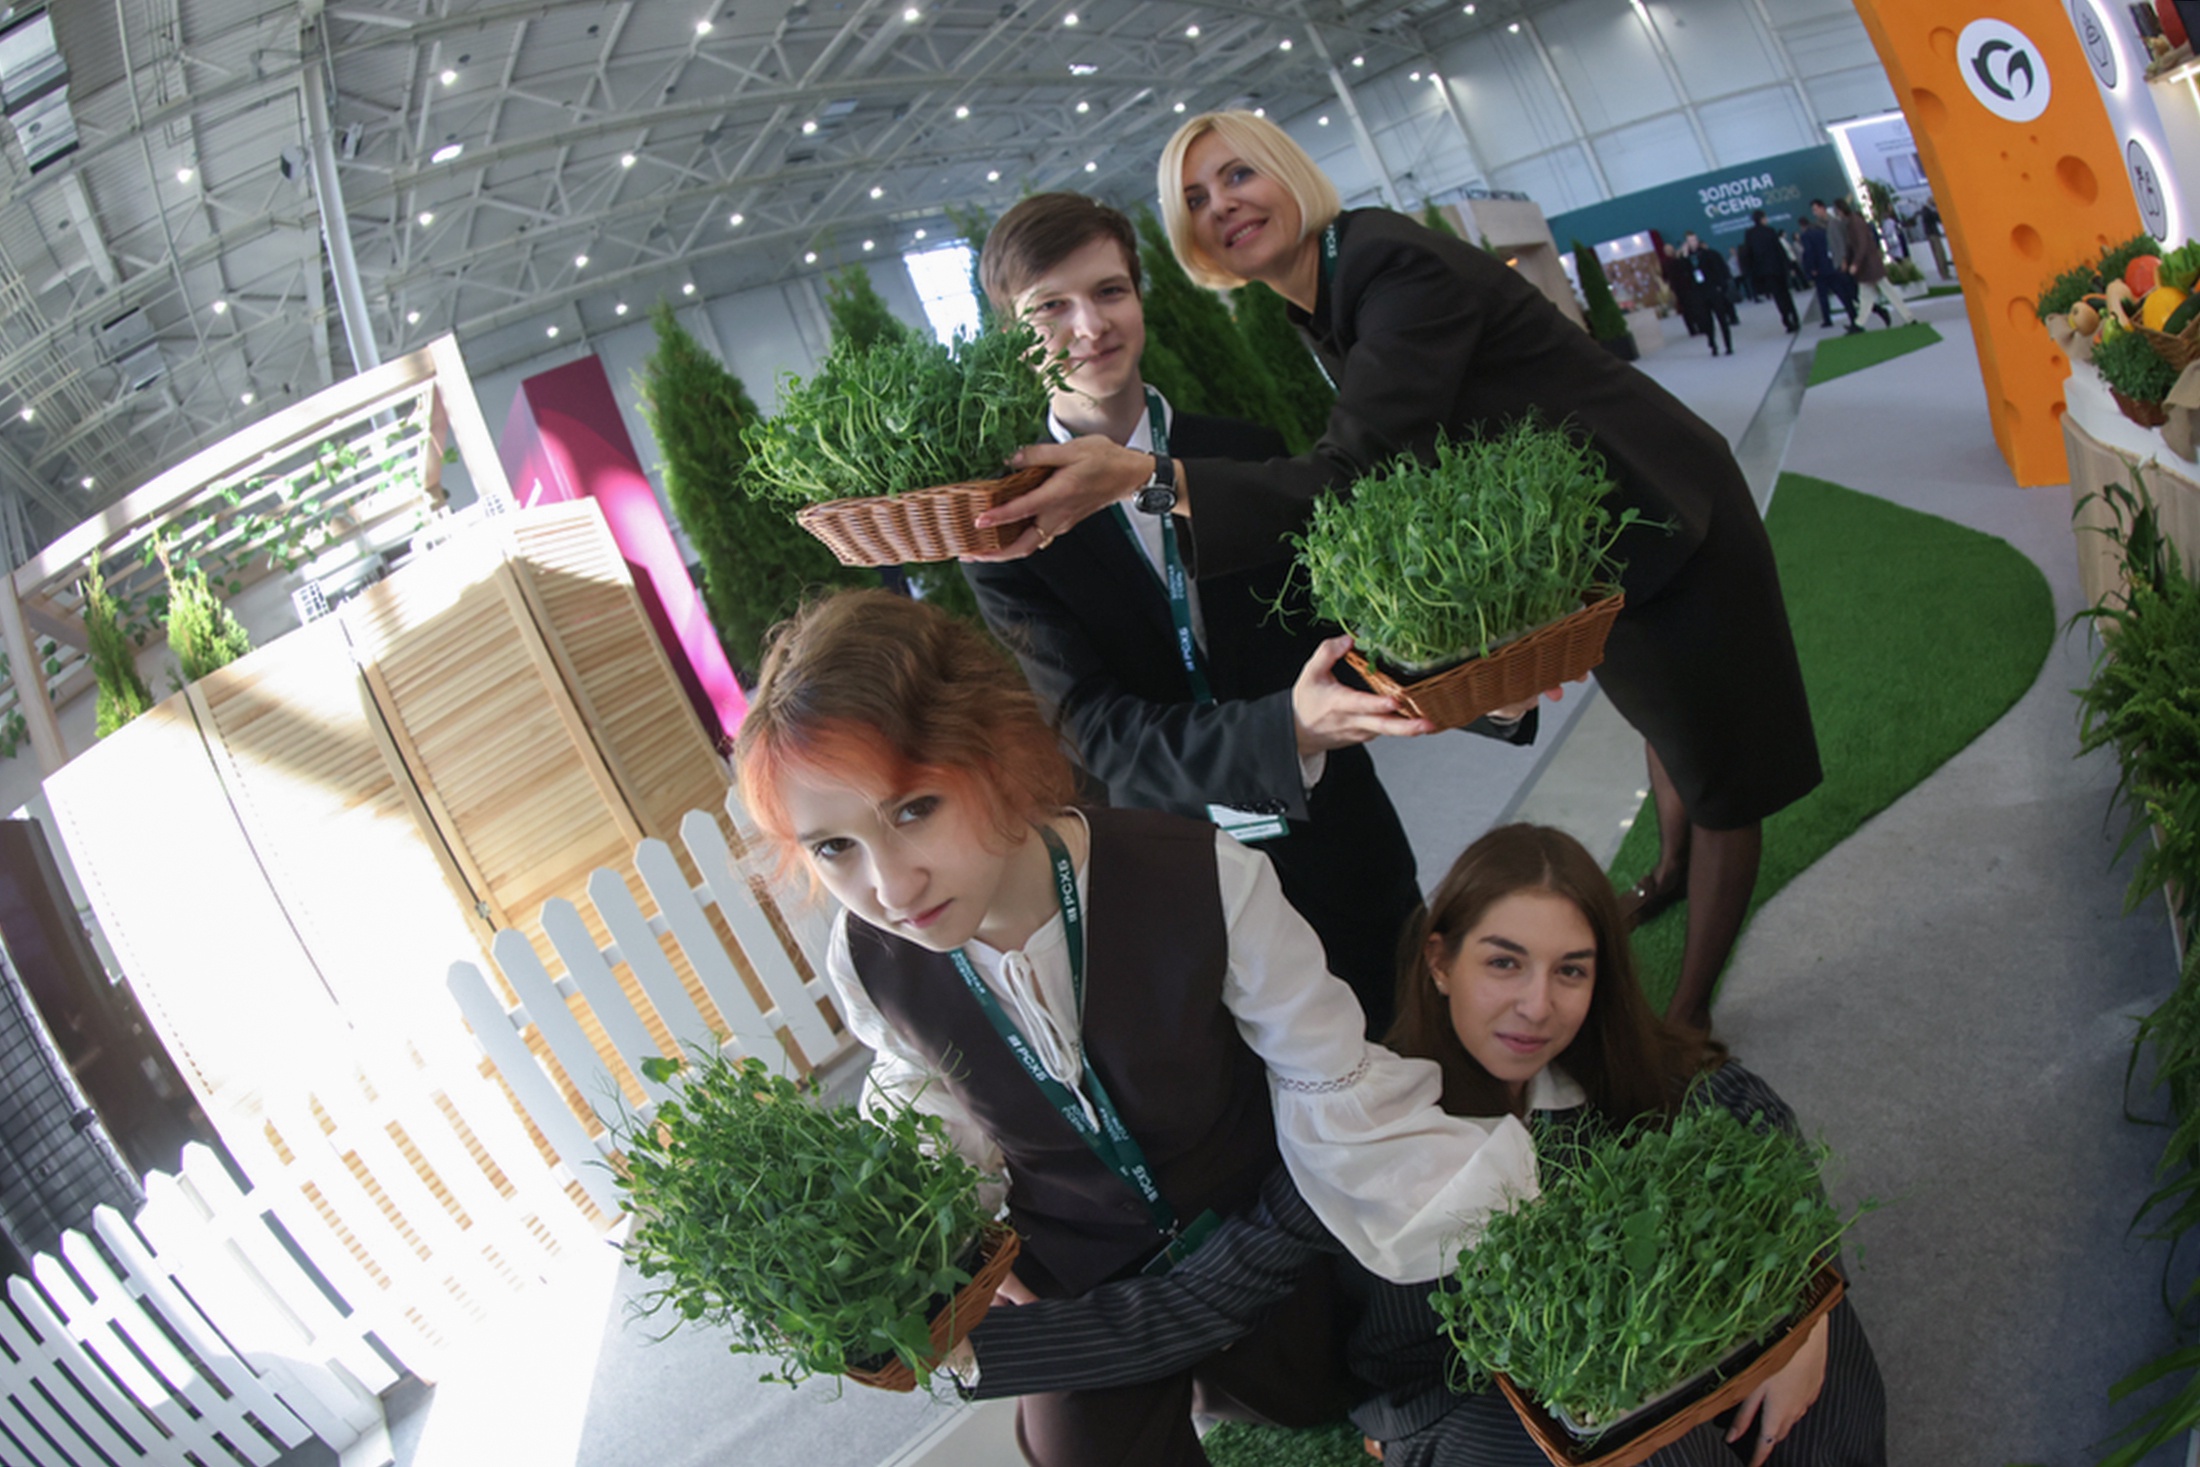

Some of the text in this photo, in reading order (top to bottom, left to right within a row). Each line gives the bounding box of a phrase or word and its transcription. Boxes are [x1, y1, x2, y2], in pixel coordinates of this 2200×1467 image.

[1698, 173, 1774, 203] ЗОЛОТАЯ
[1704, 193, 1763, 219] ОСЕНЬ
[1178, 627, 1192, 660] РСХБ
[1057, 859, 1076, 906] РСХБ
[1017, 1047, 1049, 1082] РСХБ
[1131, 1164, 1153, 1194] РСХБ
